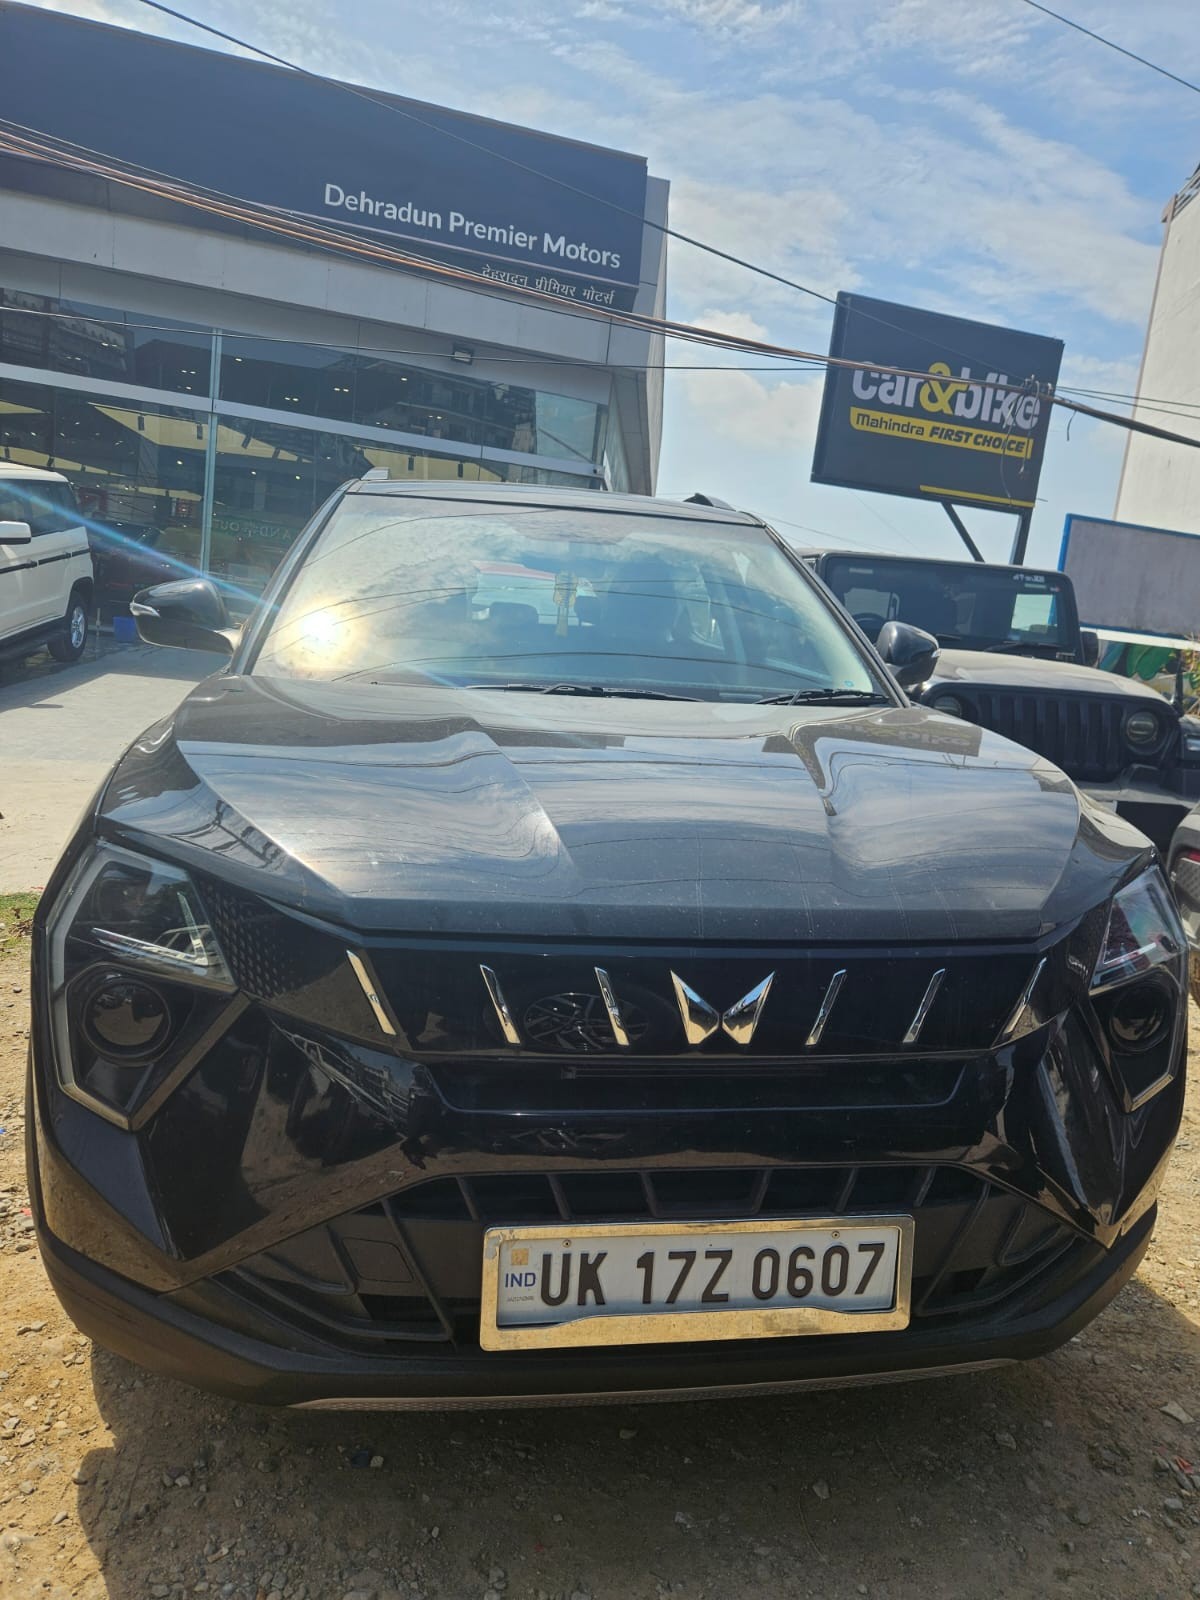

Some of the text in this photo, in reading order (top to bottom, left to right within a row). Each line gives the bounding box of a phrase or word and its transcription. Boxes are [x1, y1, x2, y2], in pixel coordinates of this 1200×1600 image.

[324, 181, 621, 269] Dehradun Premier Motors
[582, 285, 615, 305] मोटर्स
[855, 413, 1026, 453] Mahindra FIRST CHOICE
[505, 1272, 537, 1288] IND
[539, 1243, 886, 1307] UK 17Z 0607
